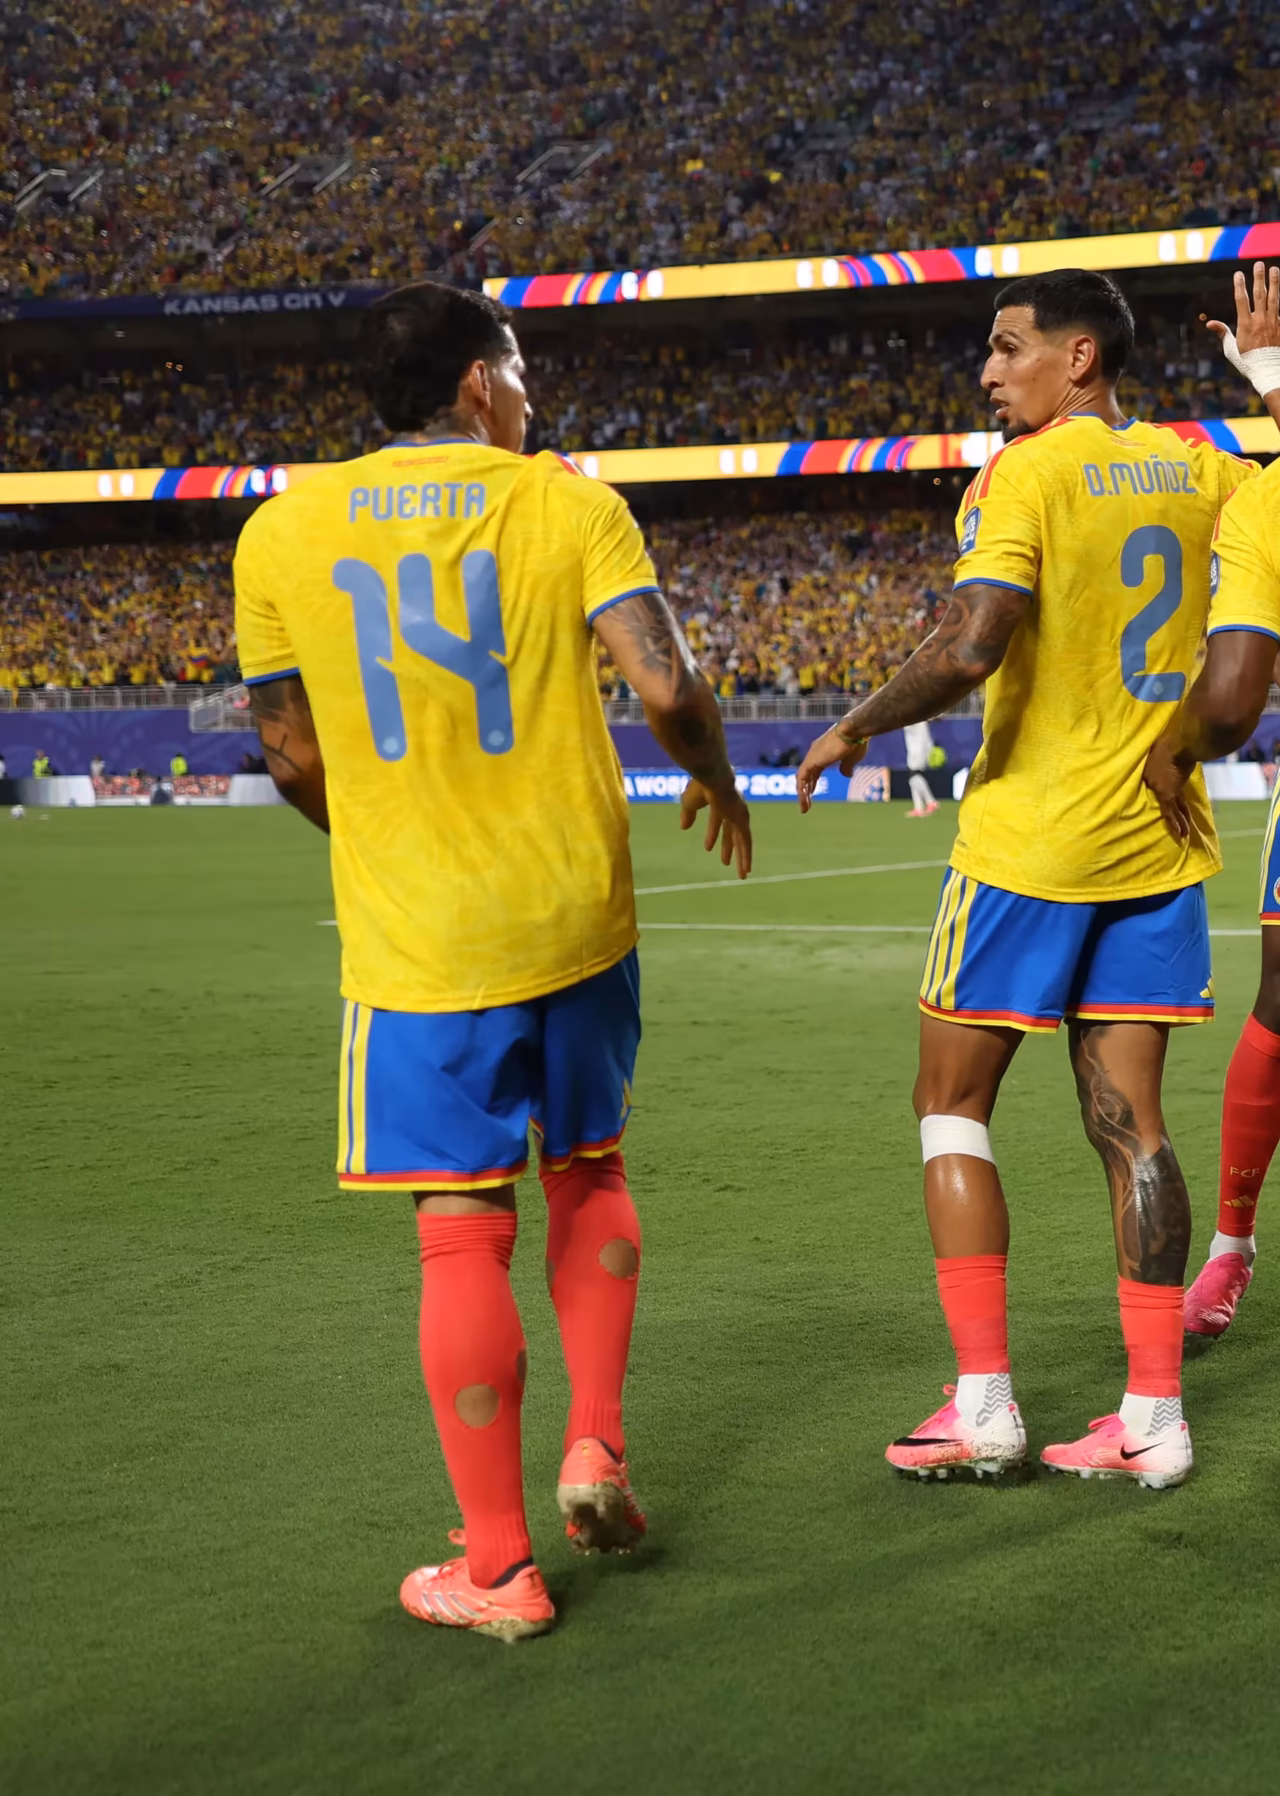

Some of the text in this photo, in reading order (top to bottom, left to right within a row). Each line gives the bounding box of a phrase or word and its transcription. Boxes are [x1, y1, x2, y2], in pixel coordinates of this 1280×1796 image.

[164, 291, 346, 315] KANSAS CITY
[349, 482, 486, 523] PUERTA
[1120, 524, 1186, 702] 2
[332, 549, 514, 762] 14
[1230, 1166, 1260, 1178] FCF
